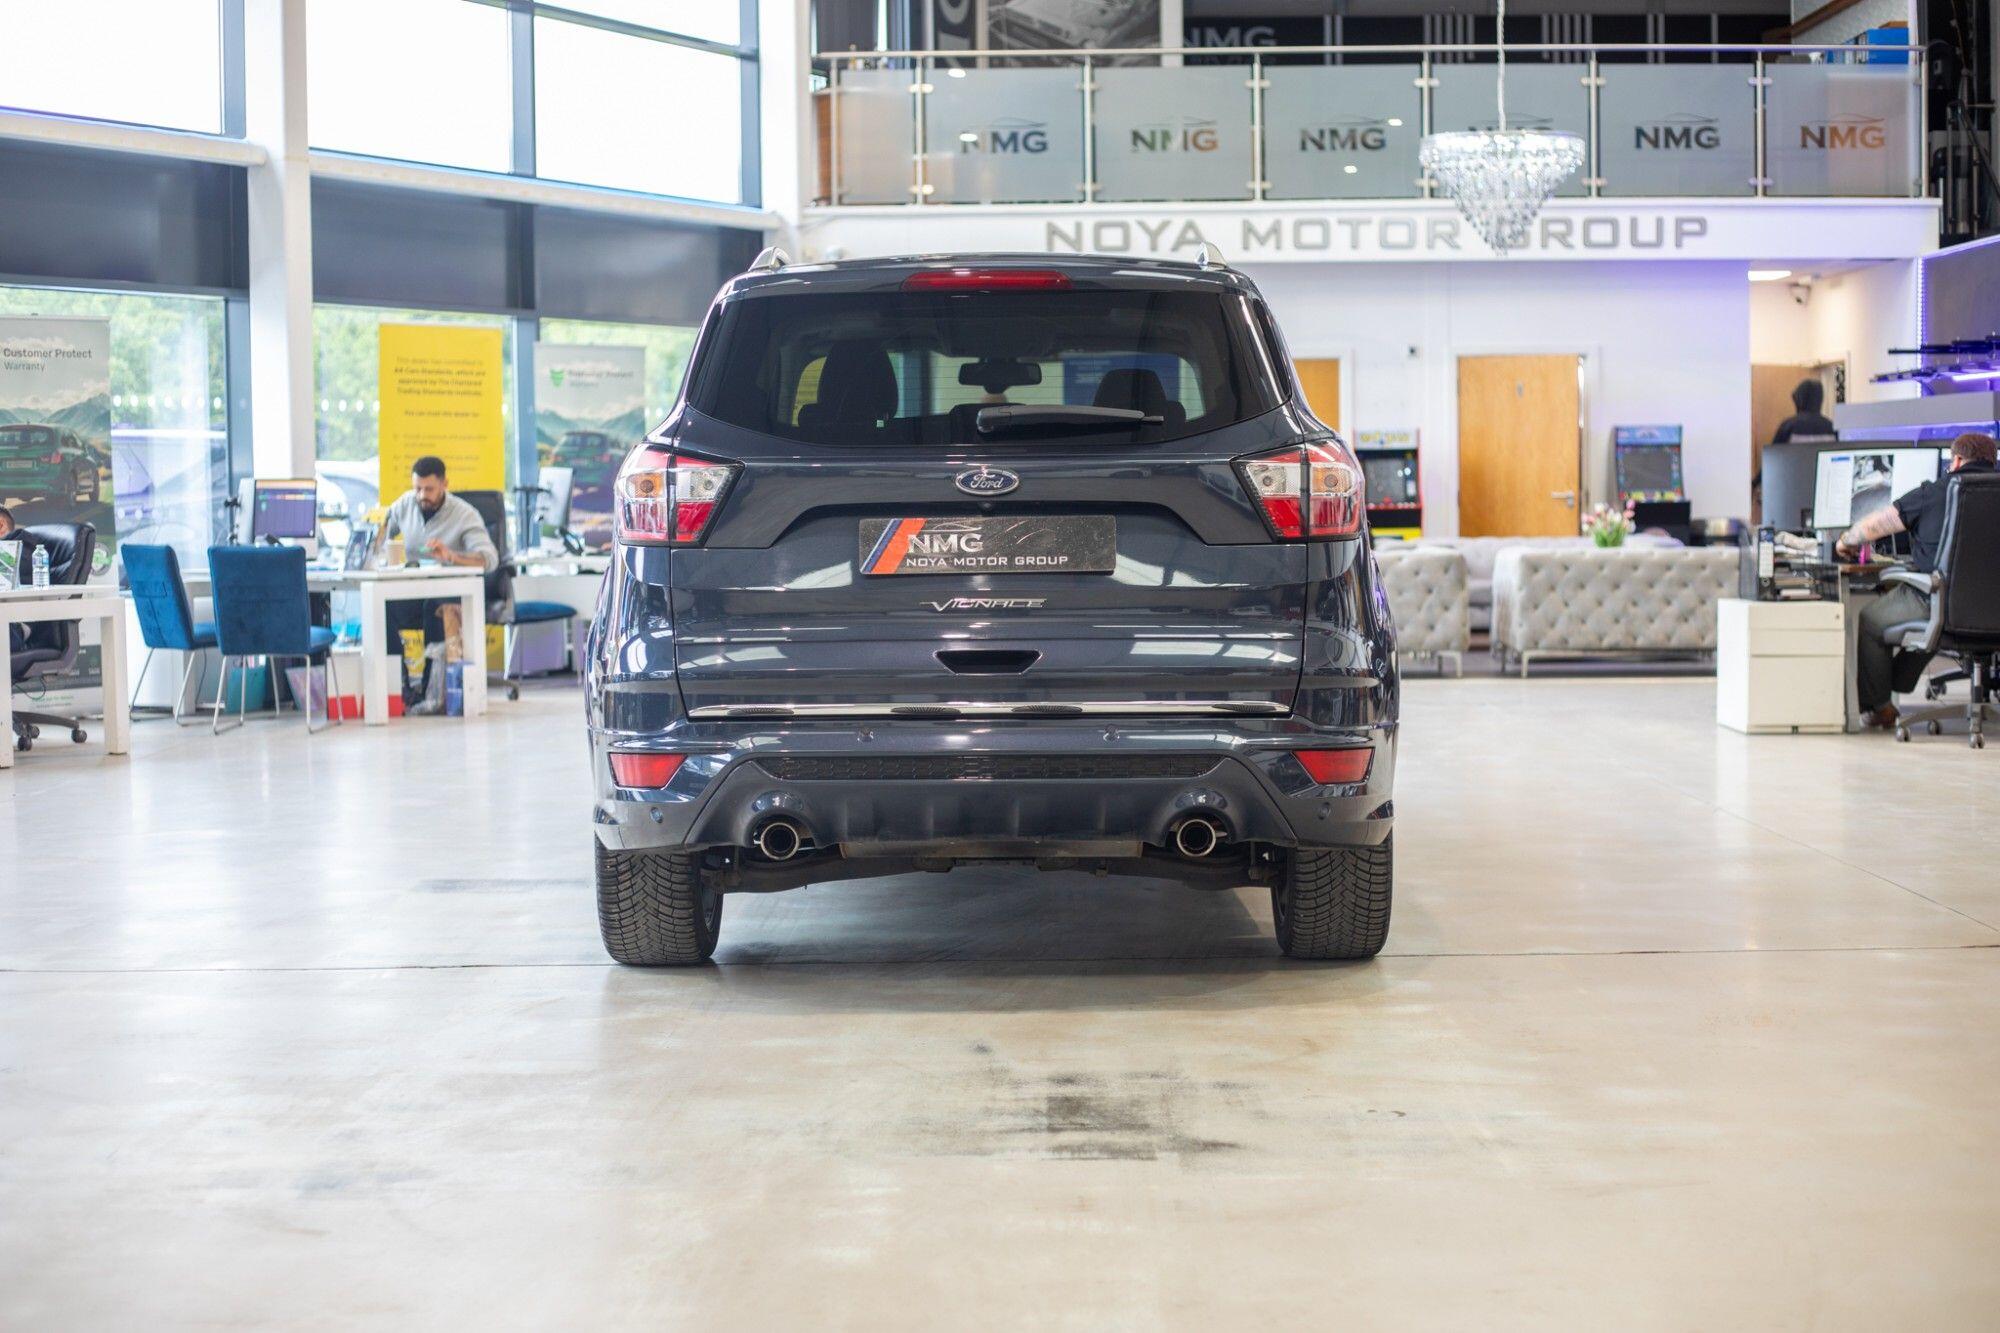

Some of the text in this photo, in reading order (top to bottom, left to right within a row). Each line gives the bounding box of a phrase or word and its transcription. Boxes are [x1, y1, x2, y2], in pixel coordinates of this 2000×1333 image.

[961, 129, 1048, 153] NMG
[1131, 128, 1218, 152] NMG
[1301, 127, 1387, 151] NMG
[1634, 125, 1721, 149] NMG
[1801, 124, 1886, 149] NMG
[1046, 220, 1203, 251] NOYA
[1242, 217, 1461, 250] MOTOR
[3, 348, 92, 359] Customer Protect
[4, 361, 46, 372] Warranty
[970, 473, 1004, 489] Ford
[908, 533, 983, 553] NMG
[906, 555, 1068, 567] NOYA MOTOR GROUP
[922, 598, 1047, 611] VIGNALE
